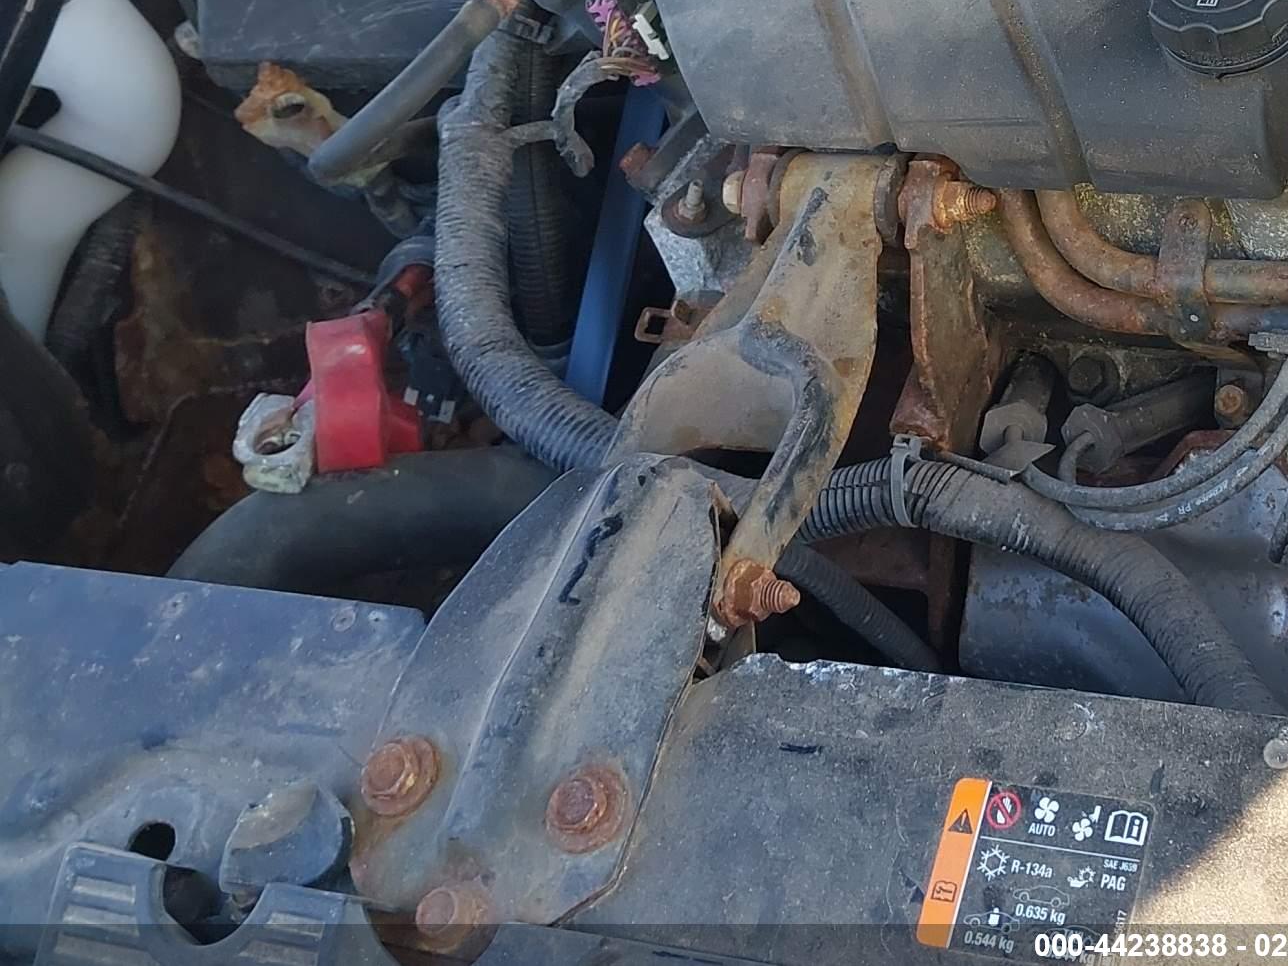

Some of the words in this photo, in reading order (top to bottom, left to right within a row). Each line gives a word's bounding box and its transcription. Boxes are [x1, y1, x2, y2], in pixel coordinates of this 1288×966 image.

[1028, 822, 1056, 837] AUTO
[1010, 859, 1053, 878] R-134a
[1103, 858, 1119, 870] SAE
[1100, 873, 1127, 891] PAG
[1015, 903, 1048, 921] 0.635
[1049, 908, 1066, 926] kg
[964, 930, 997, 948] 0.544
[998, 936, 1015, 954] kg
